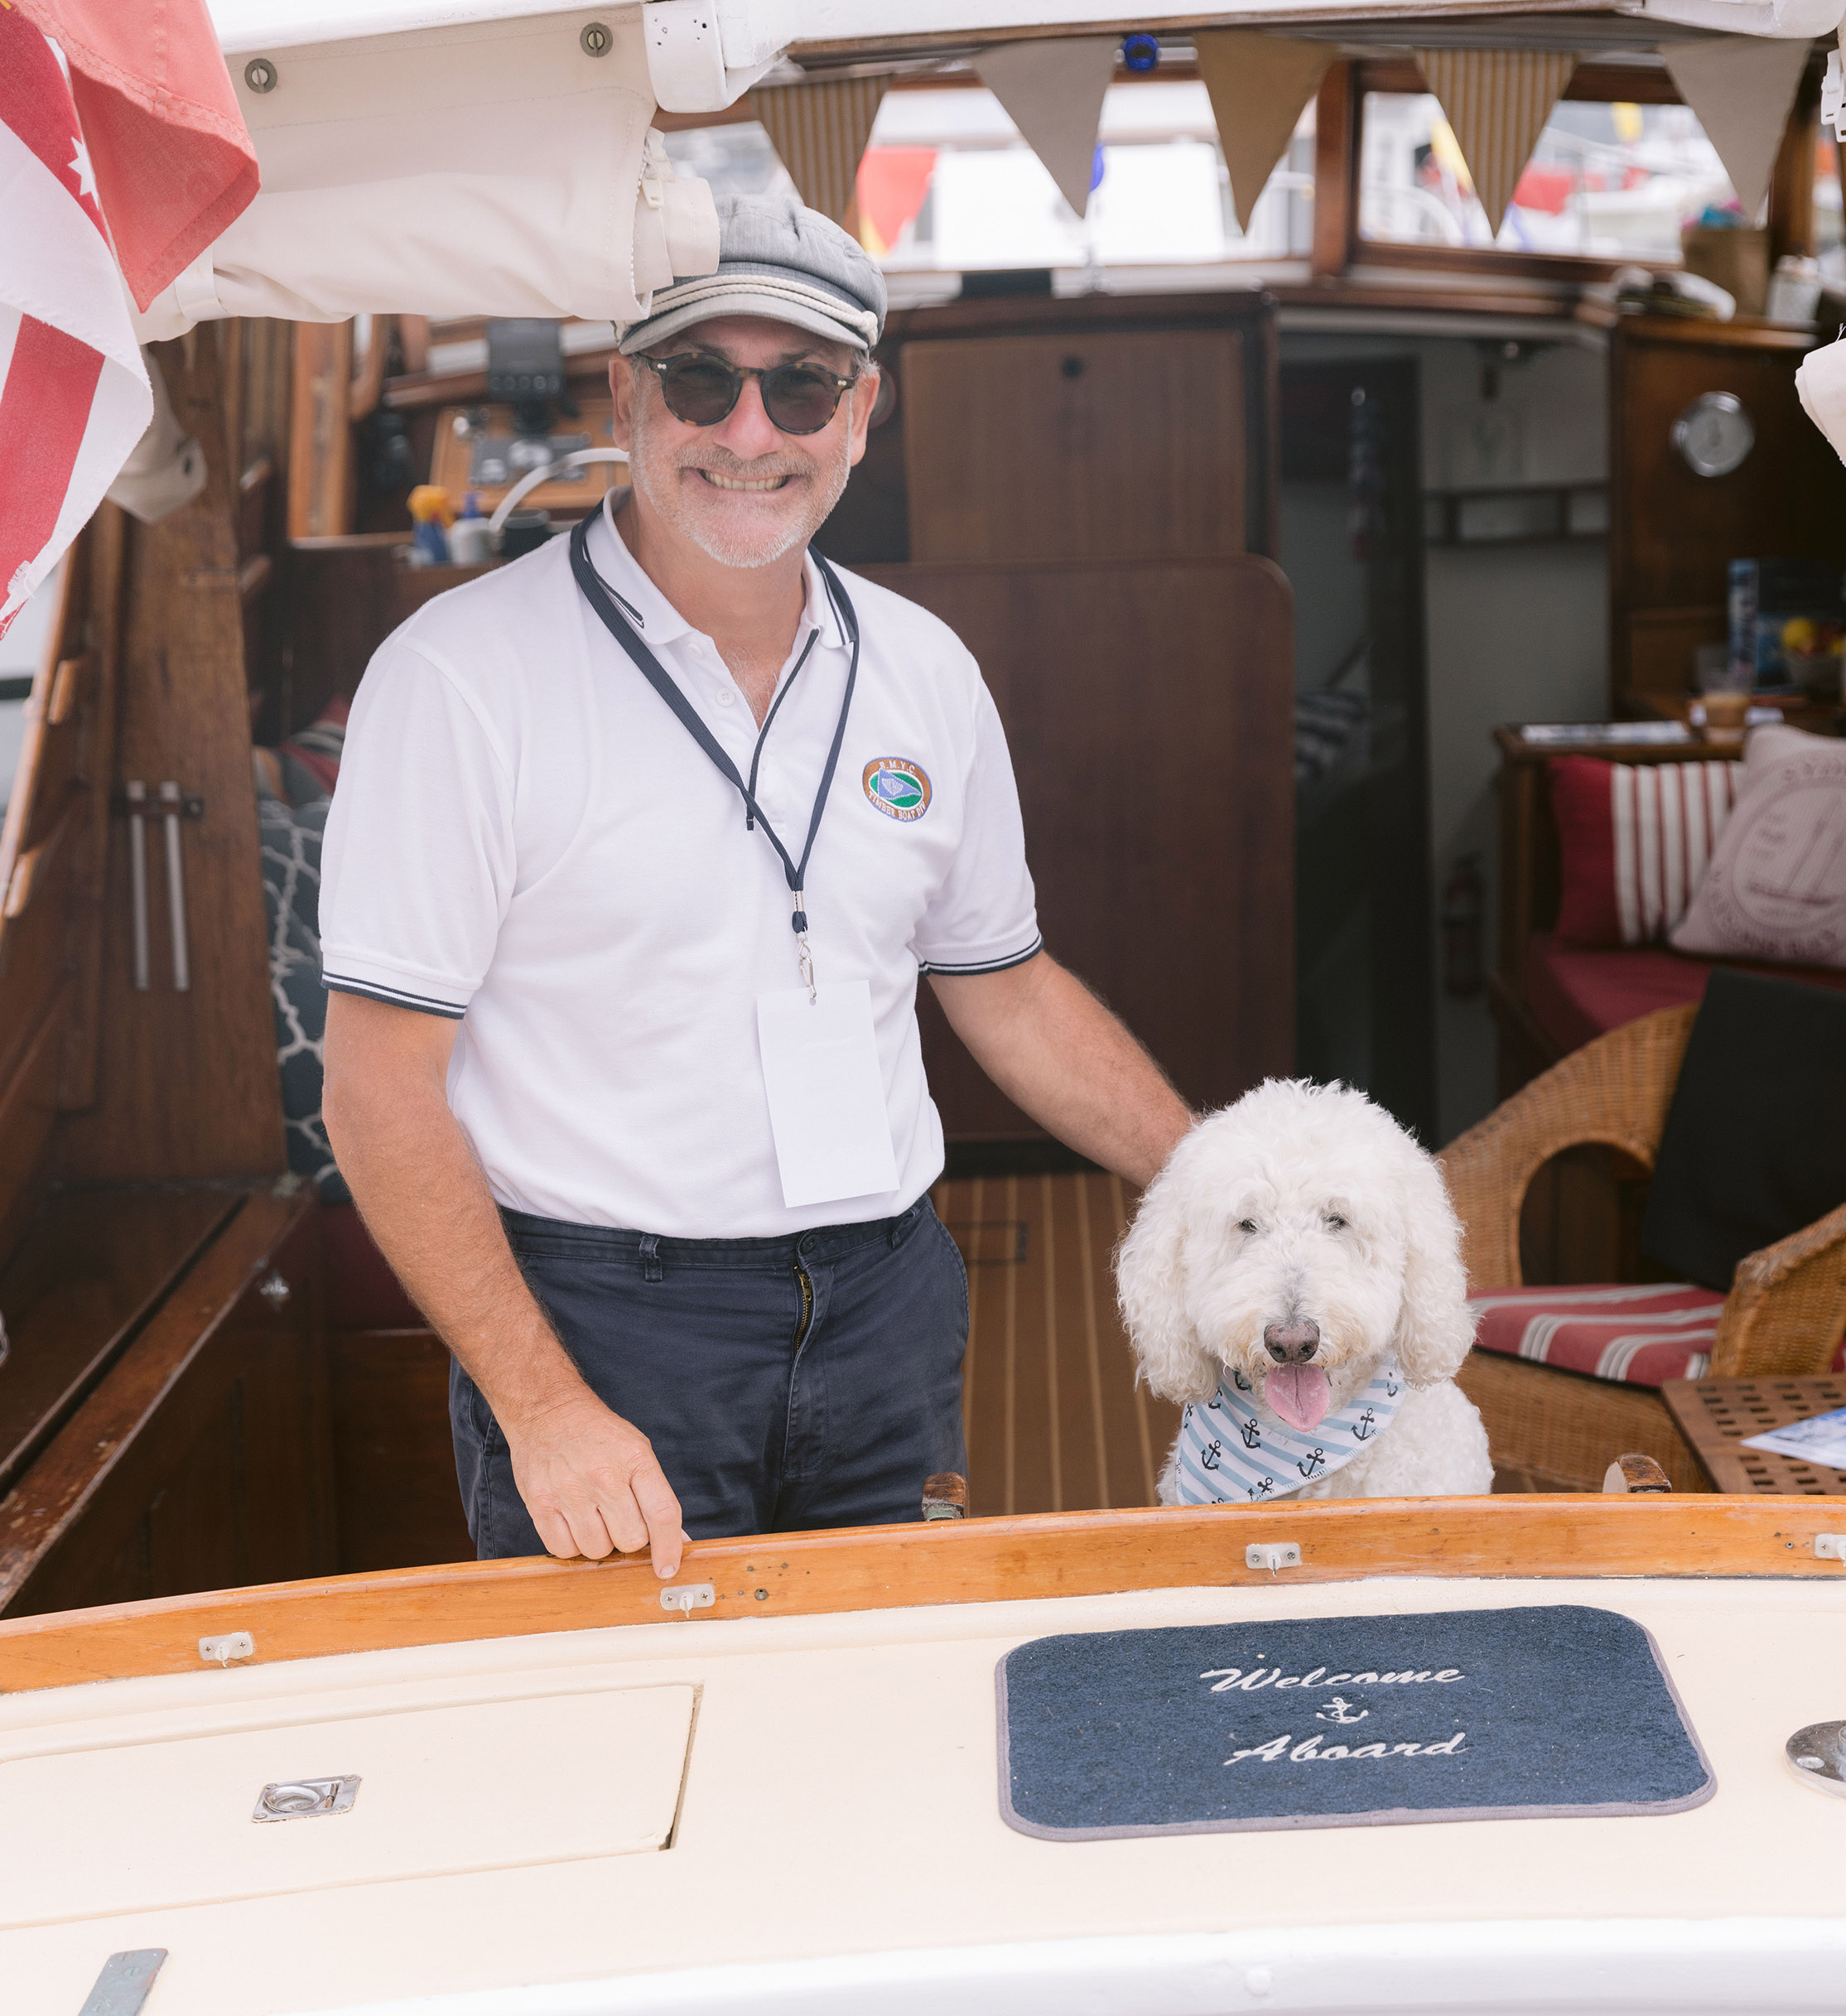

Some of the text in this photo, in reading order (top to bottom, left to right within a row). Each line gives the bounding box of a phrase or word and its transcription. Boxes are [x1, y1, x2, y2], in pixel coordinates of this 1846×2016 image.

[868, 790, 926, 821] TIMBER BOAT DIV
[1199, 1666, 1466, 1692] Welcome
[1223, 1732, 1469, 1766] Aboard
